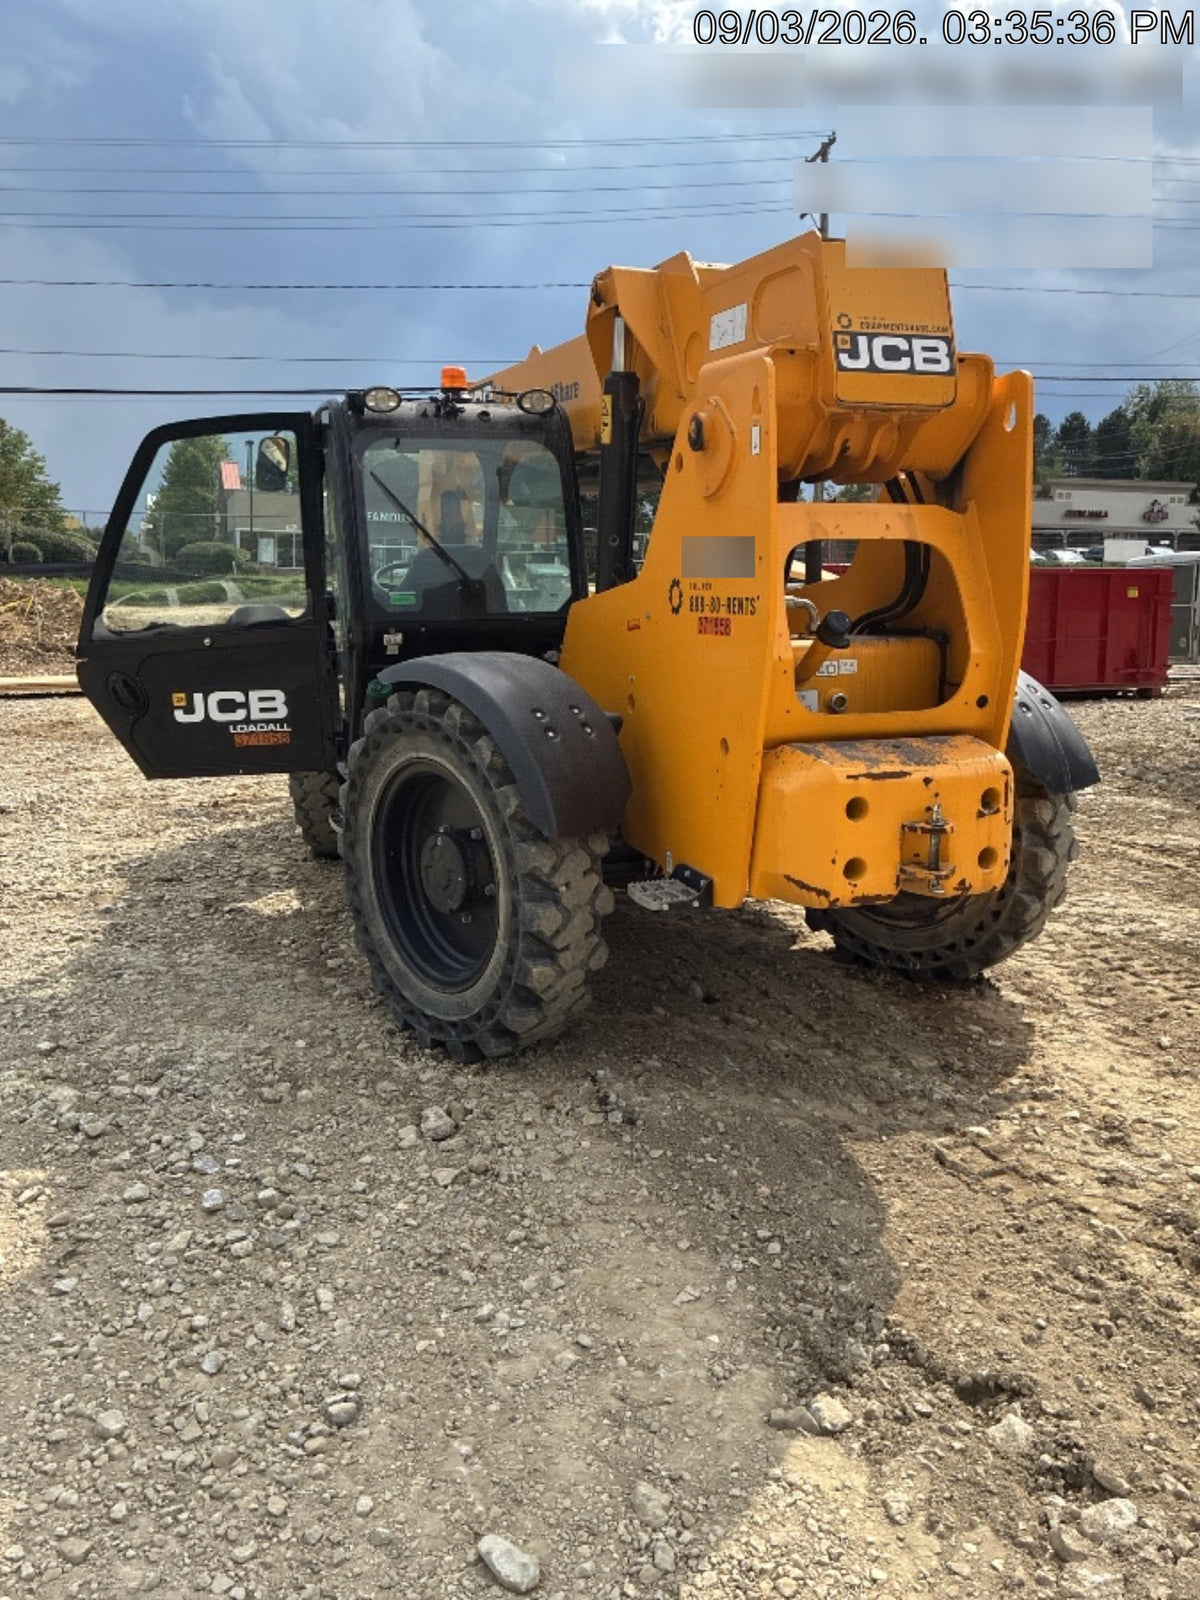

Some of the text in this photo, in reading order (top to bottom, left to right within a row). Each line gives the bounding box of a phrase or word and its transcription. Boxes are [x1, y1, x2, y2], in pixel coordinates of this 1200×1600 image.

[838, 335, 951, 372] JCB
[173, 689, 289, 723] JCB
[229, 723, 292, 733] LOADALL
